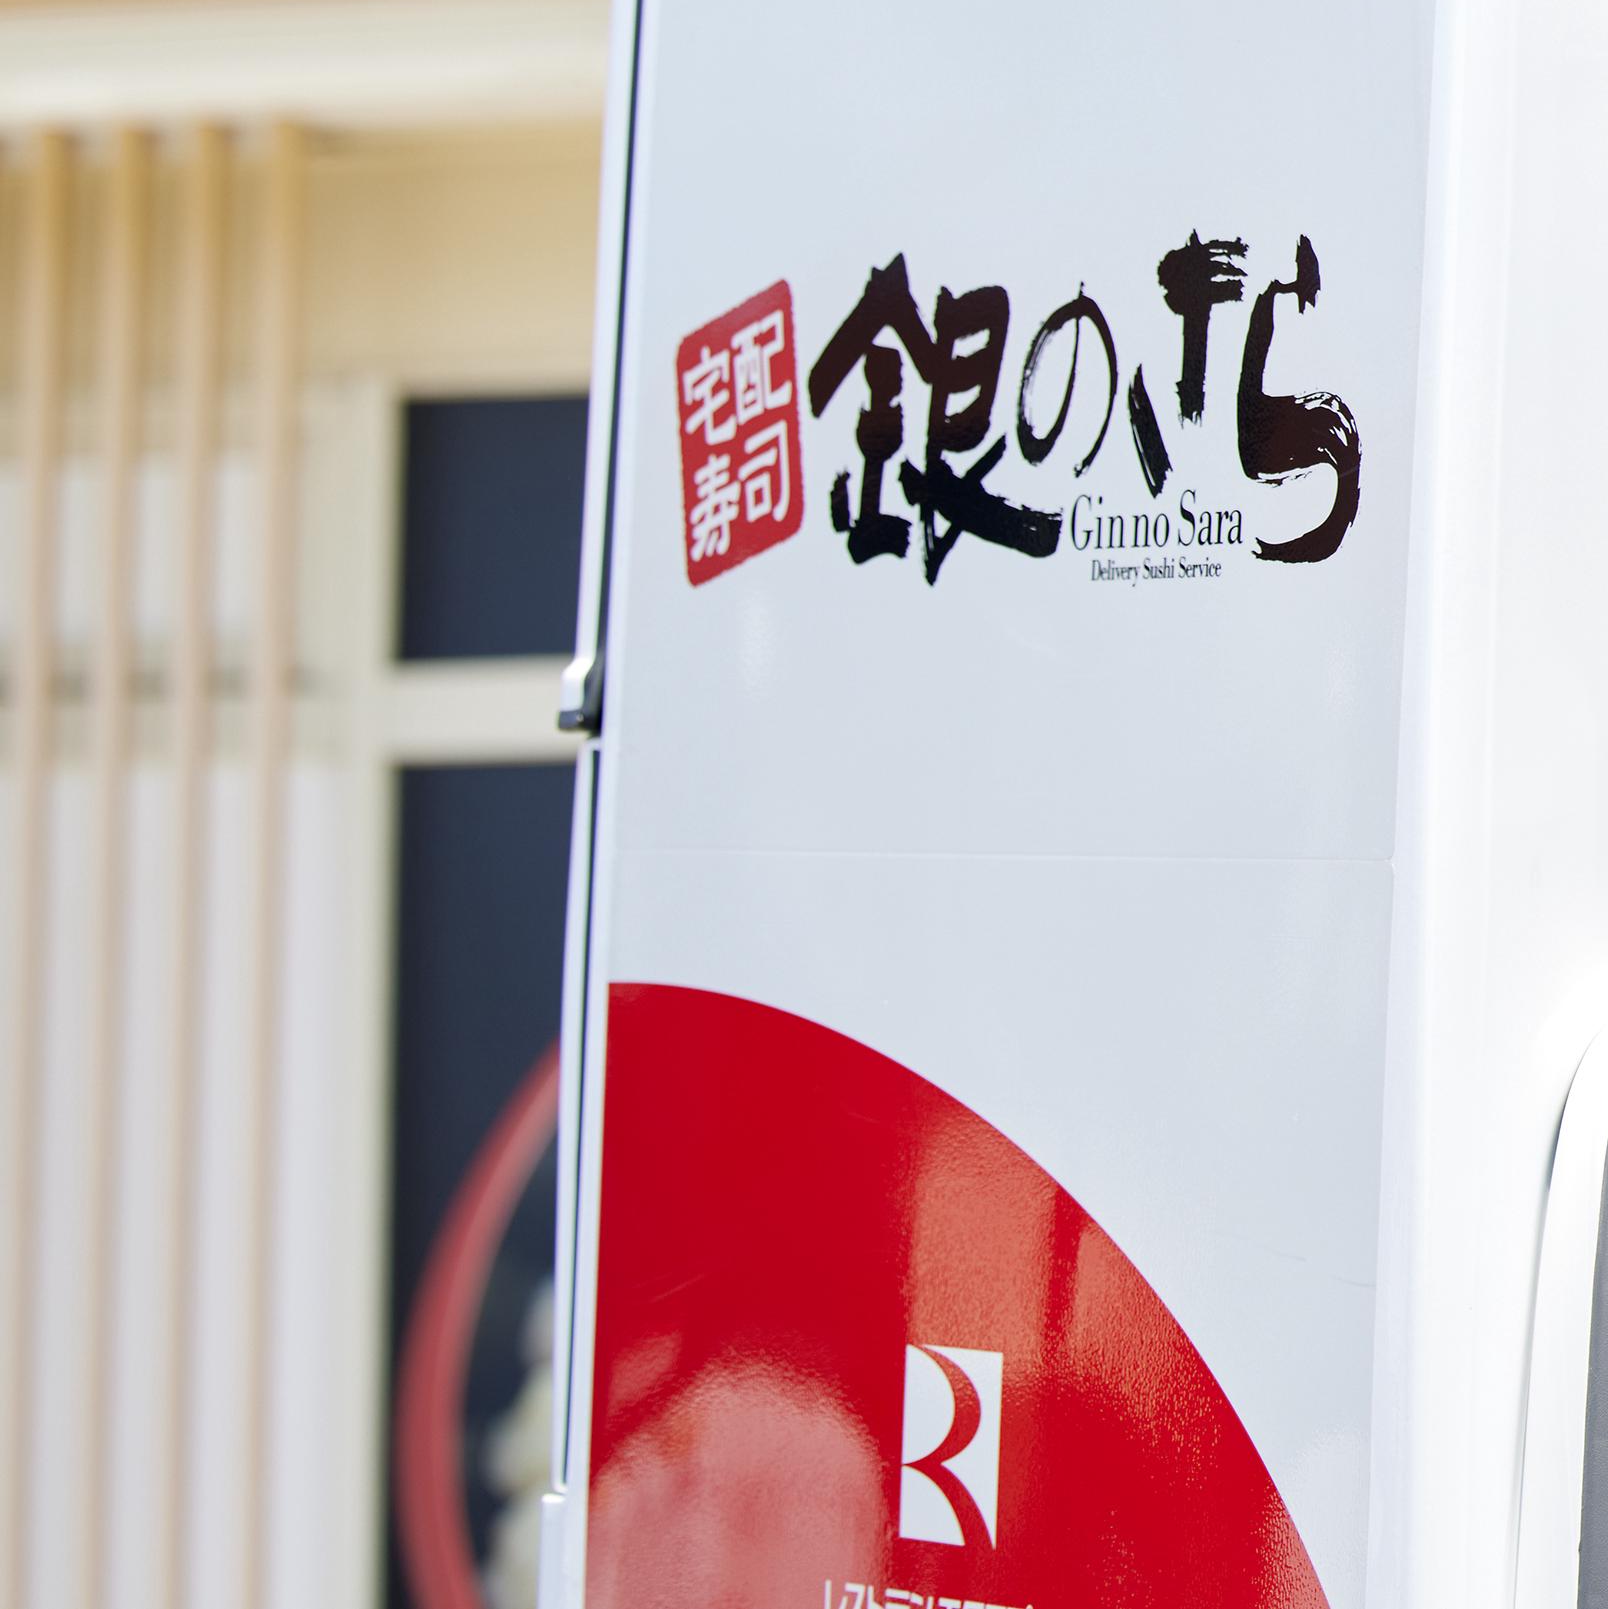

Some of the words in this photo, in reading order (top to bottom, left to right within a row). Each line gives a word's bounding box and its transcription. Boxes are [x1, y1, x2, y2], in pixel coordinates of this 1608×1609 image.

[1177, 488, 1244, 546] Sara
[1091, 558, 1140, 587] Delivery
[1142, 557, 1175, 580] Sushi
[1178, 555, 1222, 579] Service
